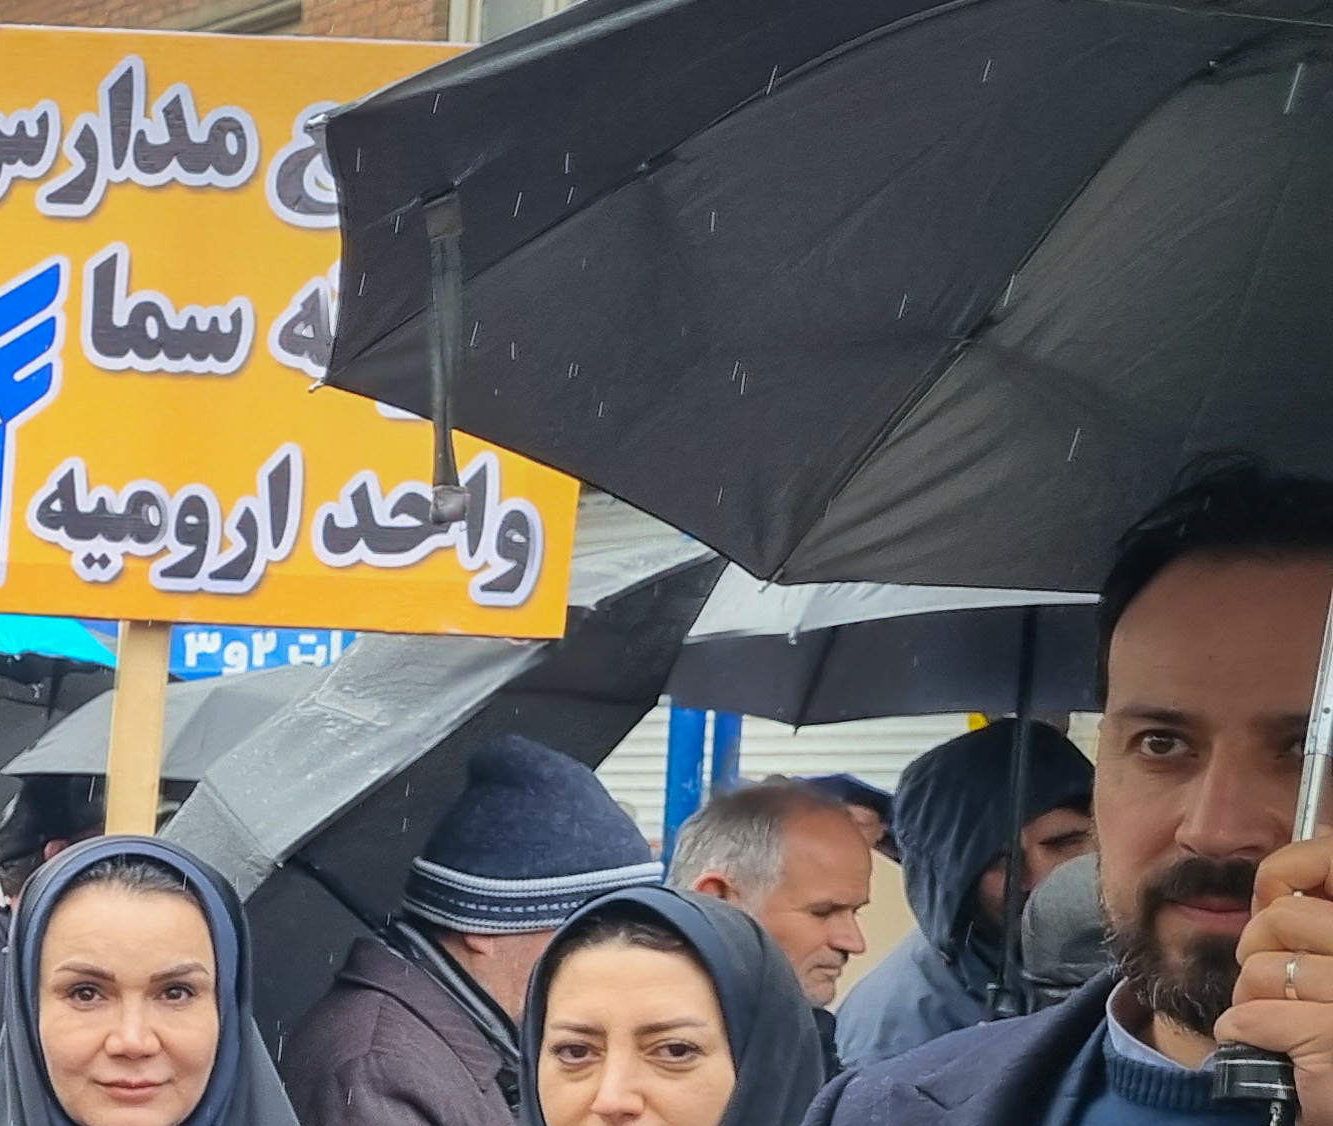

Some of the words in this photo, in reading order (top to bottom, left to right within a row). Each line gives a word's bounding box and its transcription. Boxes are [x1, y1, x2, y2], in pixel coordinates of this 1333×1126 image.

[90, 252, 243, 363] سما
[36, 453, 293, 580] ارومیه
[322, 463, 529, 593] واحد
